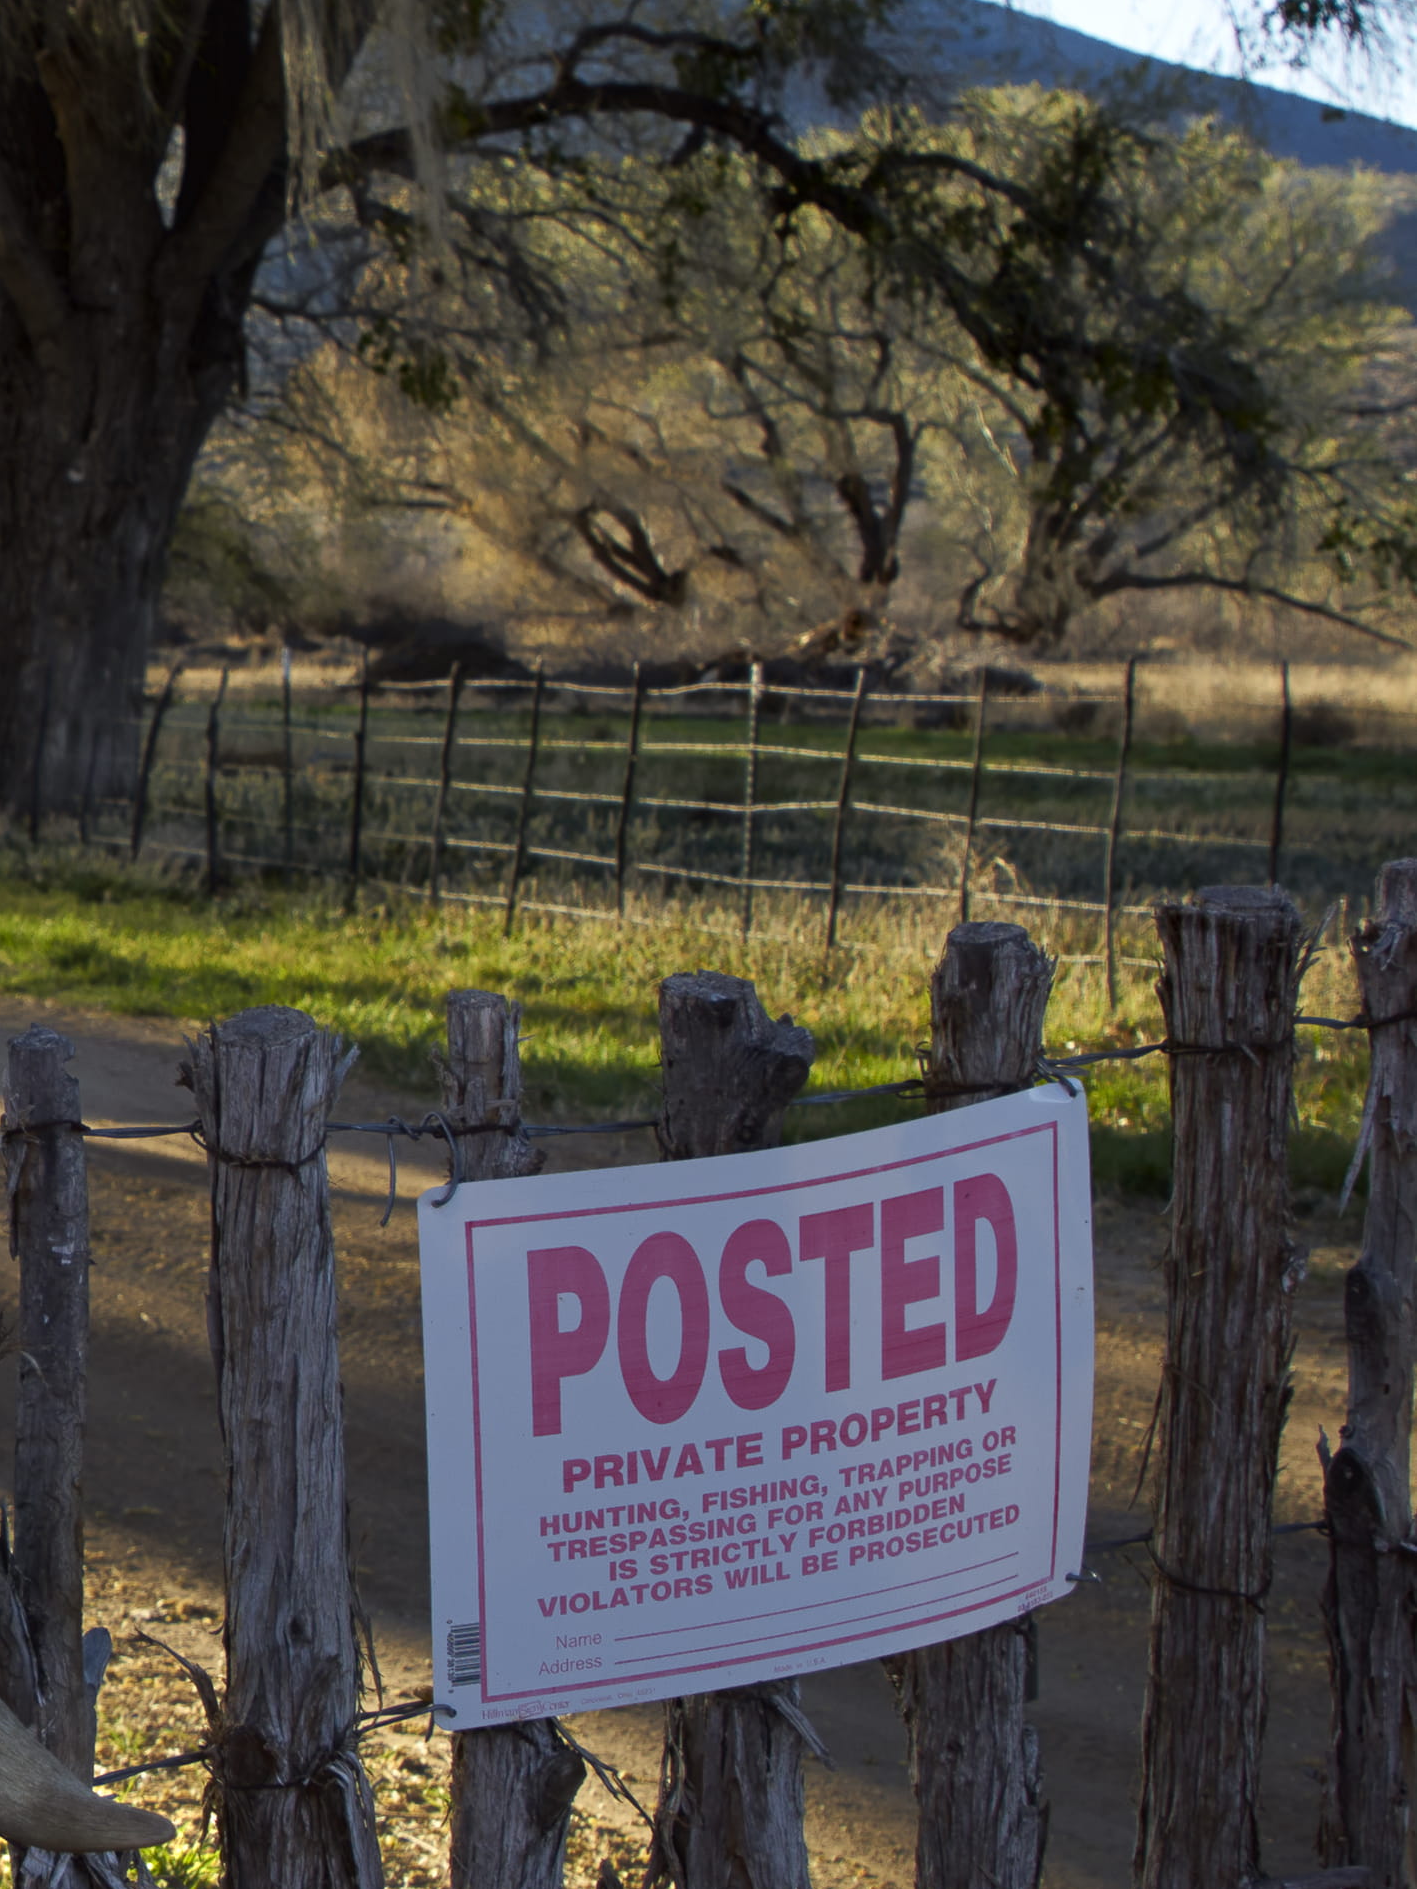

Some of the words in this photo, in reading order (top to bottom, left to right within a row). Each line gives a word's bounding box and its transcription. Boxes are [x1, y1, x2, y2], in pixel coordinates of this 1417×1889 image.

[527, 1172, 1018, 1437] POSTED
[539, 1498, 691, 1538] HUNTING,
[702, 1474, 829, 1514] FISHING,
[840, 1438, 973, 1489] TRAPPING
[982, 1426, 1017, 1452] OR
[562, 1431, 764, 1494] PRIVATE
[782, 1378, 998, 1460] PROPERTY
[537, 1575, 714, 1618] VIOLATORS
[724, 1560, 791, 1588] WILL
[802, 1549, 838, 1576] BE
[848, 1505, 1020, 1567] PROSECUTED
[547, 1514, 757, 1563] TRESPASSING
[767, 1501, 823, 1530] FOR
[834, 1486, 889, 1516] ANY
[898, 1453, 1013, 1502] PURPOSE
[609, 1558, 640, 1582] IS
[650, 1532, 797, 1576] STRICTLY
[808, 1493, 966, 1548] FORBIDDEN
[538, 1655, 603, 1676] Address
[555, 1631, 602, 1650] Name
